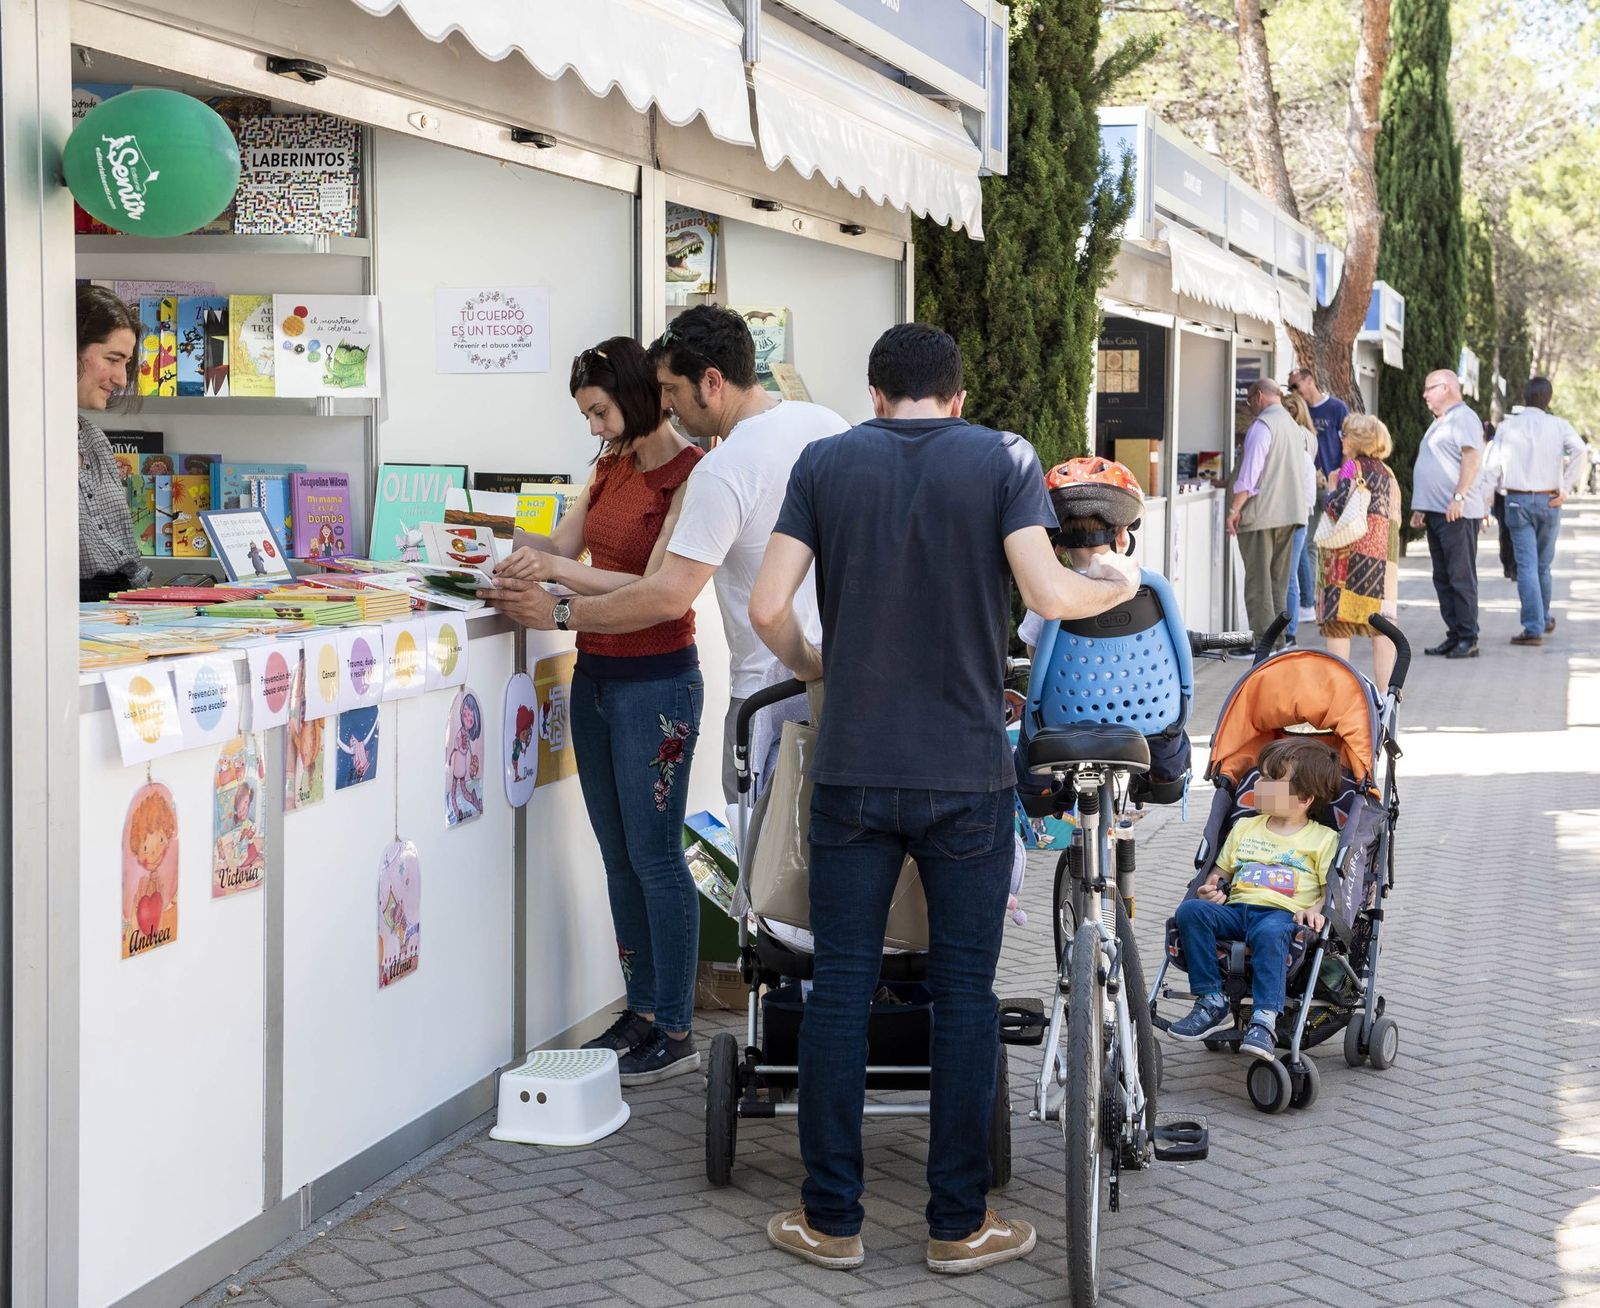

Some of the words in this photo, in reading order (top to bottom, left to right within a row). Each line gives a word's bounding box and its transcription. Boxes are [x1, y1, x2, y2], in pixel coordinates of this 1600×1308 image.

[252, 152, 345, 168] LABERINTOS
[460, 310, 475, 321] TU
[477, 309, 525, 321] CUERPO
[451, 325, 465, 337] ES
[467, 325, 484, 336] UN
[486, 324, 534, 336] TESORO
[453, 342, 479, 350] Prevenir
[481, 341, 488, 349] el
[490, 341, 509, 349] abuso
[511, 341, 532, 349] sexual
[383, 471, 455, 503] OLIVIA
[308, 511, 345, 524] bomba
[190, 704, 208, 714] acoso
[208, 699, 228, 711] escolar
[217, 864, 259, 889] Victoria
[128, 925, 171, 954] Andrea
